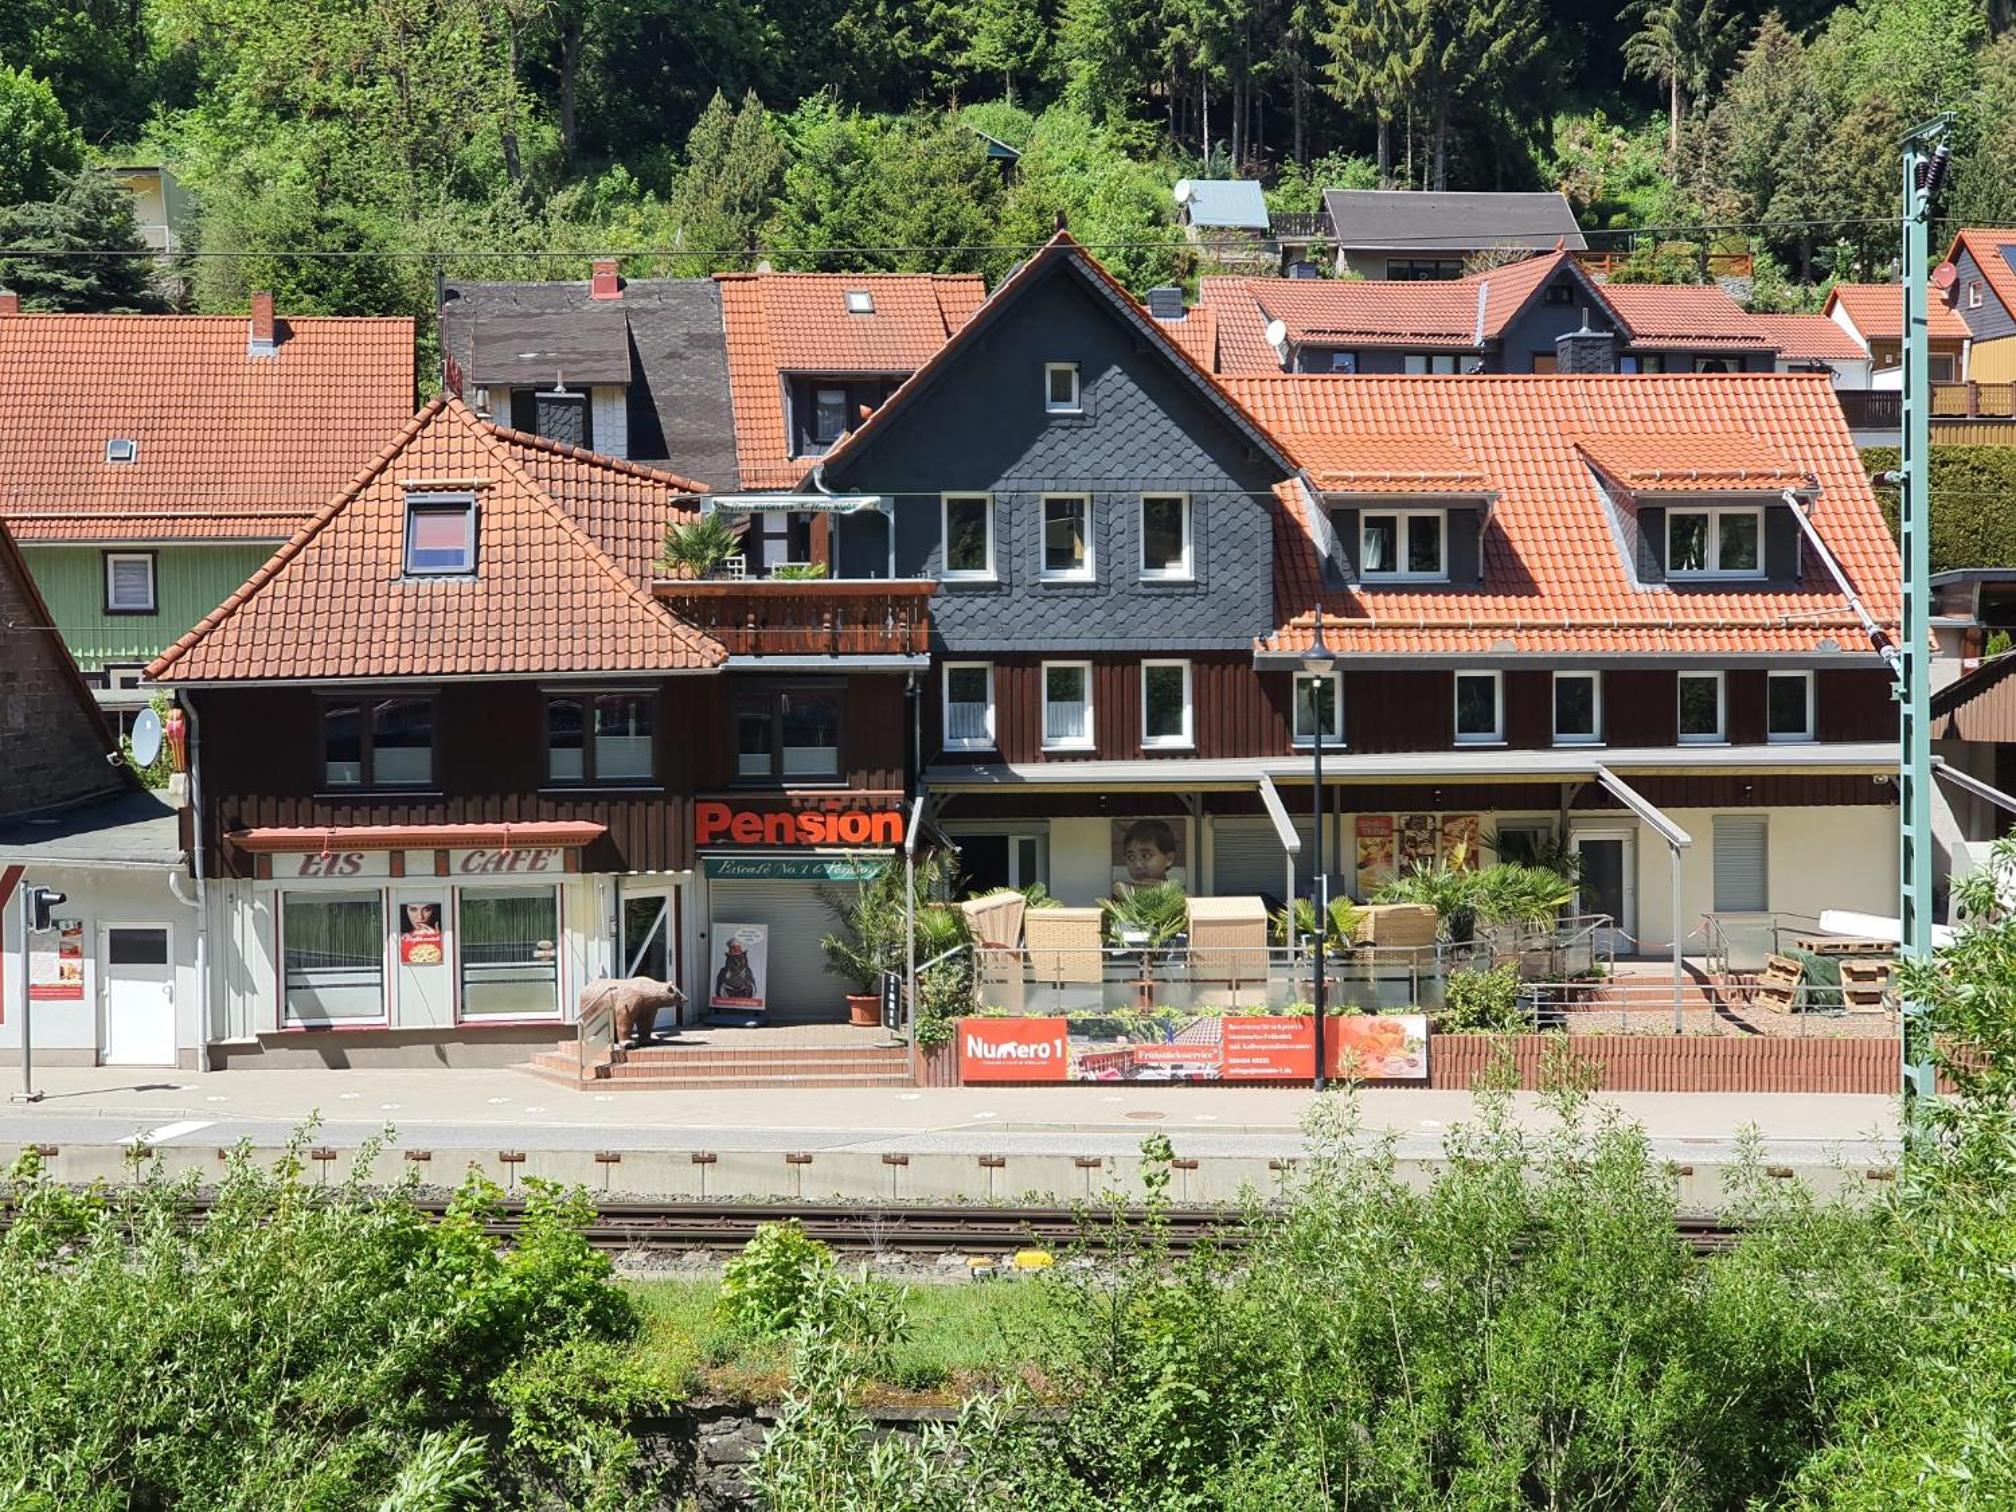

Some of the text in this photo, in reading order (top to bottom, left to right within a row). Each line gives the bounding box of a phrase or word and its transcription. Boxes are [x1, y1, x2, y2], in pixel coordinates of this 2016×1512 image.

[695, 801, 904, 845] Pension
[298, 851, 365, 876] EIS
[967, 1033, 1063, 1059] Numero 1
